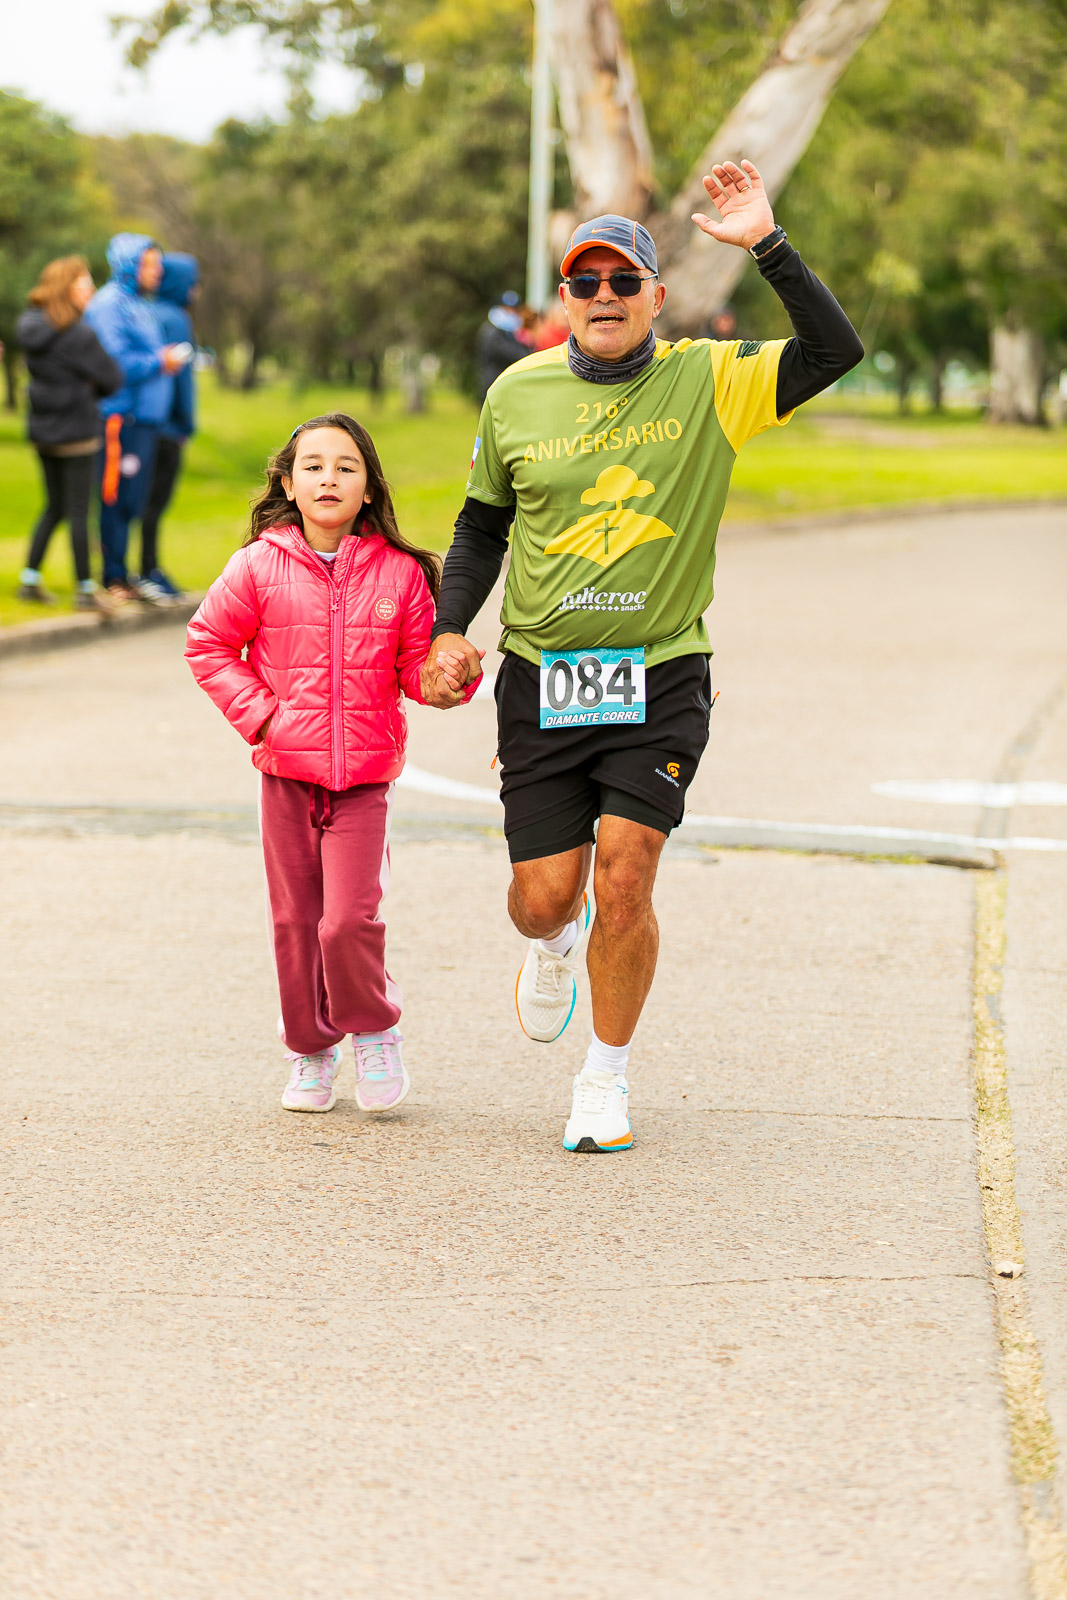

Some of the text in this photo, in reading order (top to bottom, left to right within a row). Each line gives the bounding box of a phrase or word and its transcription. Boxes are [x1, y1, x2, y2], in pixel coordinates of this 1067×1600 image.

[523, 418, 683, 464] ANIVERSARIO
[559, 586, 647, 611] julicroc
[620, 604, 645, 612] snacks
[546, 656, 637, 712] 084
[545, 711, 640, 726] DIAMANTE CORRE
